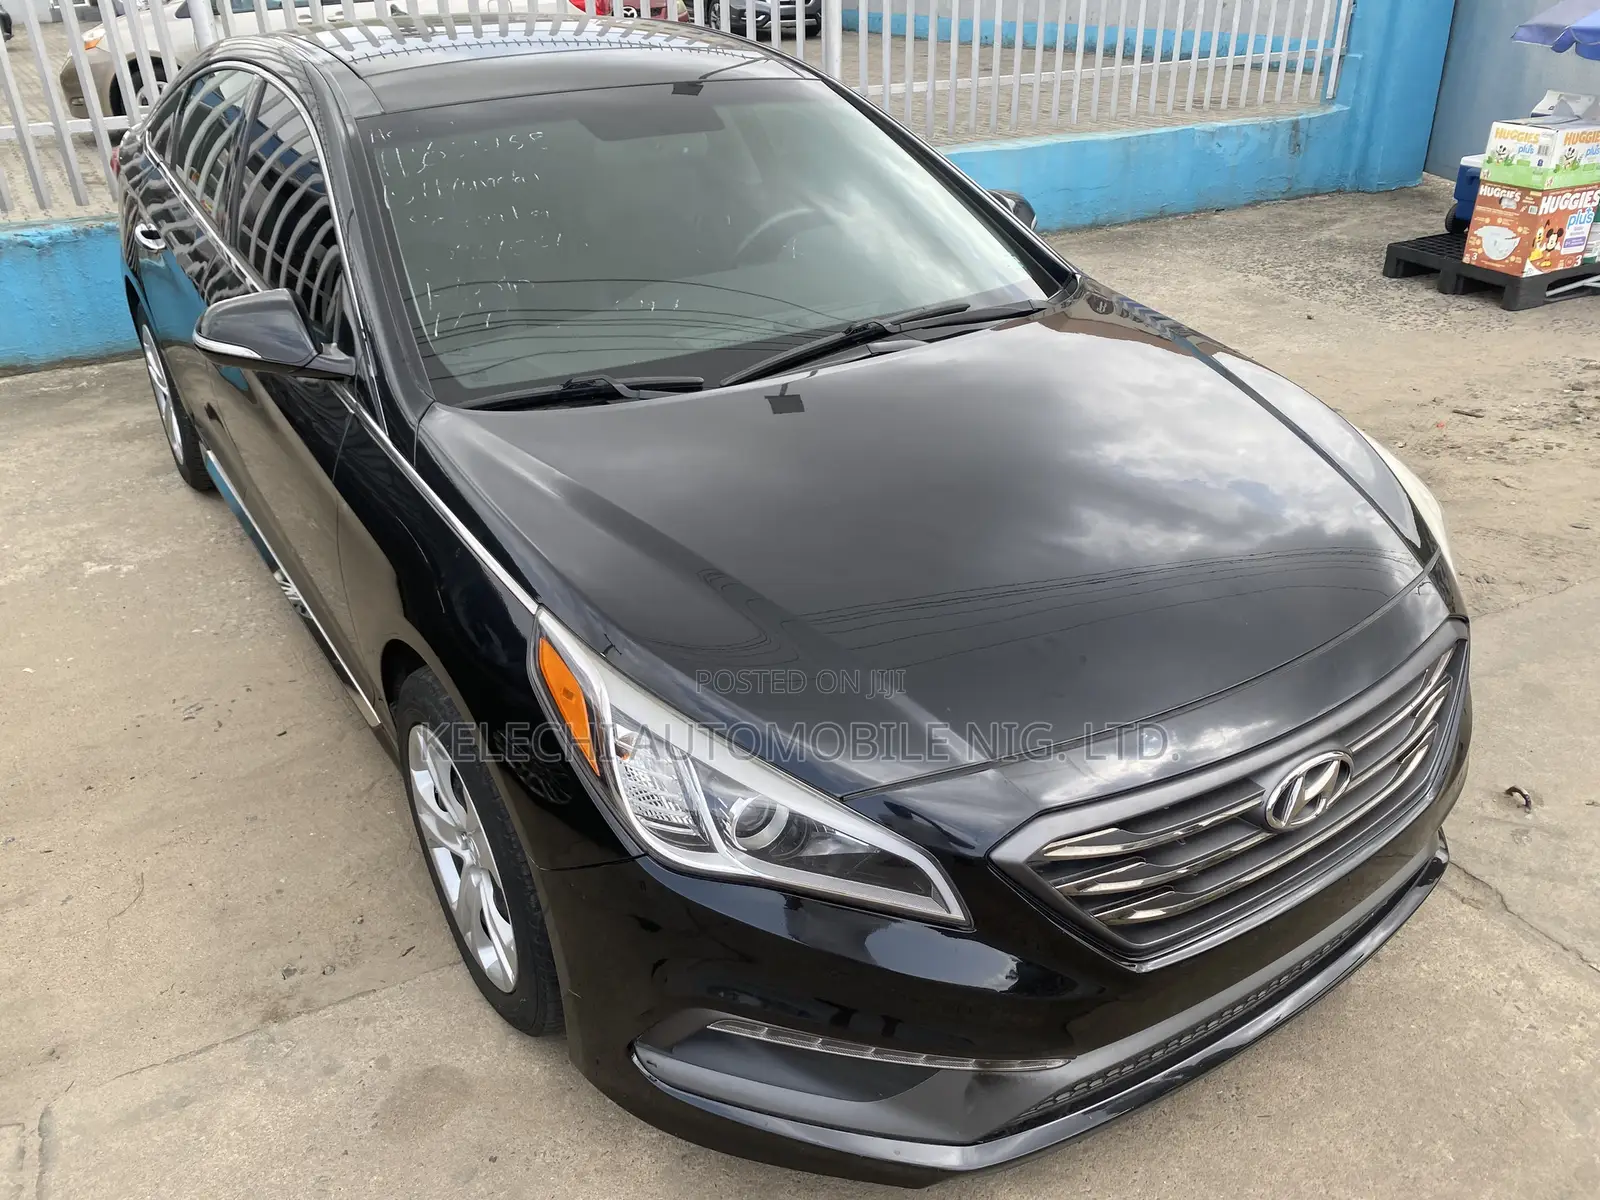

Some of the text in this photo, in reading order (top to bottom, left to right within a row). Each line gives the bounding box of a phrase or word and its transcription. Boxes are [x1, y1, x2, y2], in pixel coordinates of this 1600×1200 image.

[1495, 128, 1540, 144] HUGGIES
[1480, 185, 1521, 202] HUGGIES
[1539, 189, 1600, 216] HUGGIES
[1567, 207, 1595, 229] plus
[1574, 255, 1582, 267] 3
